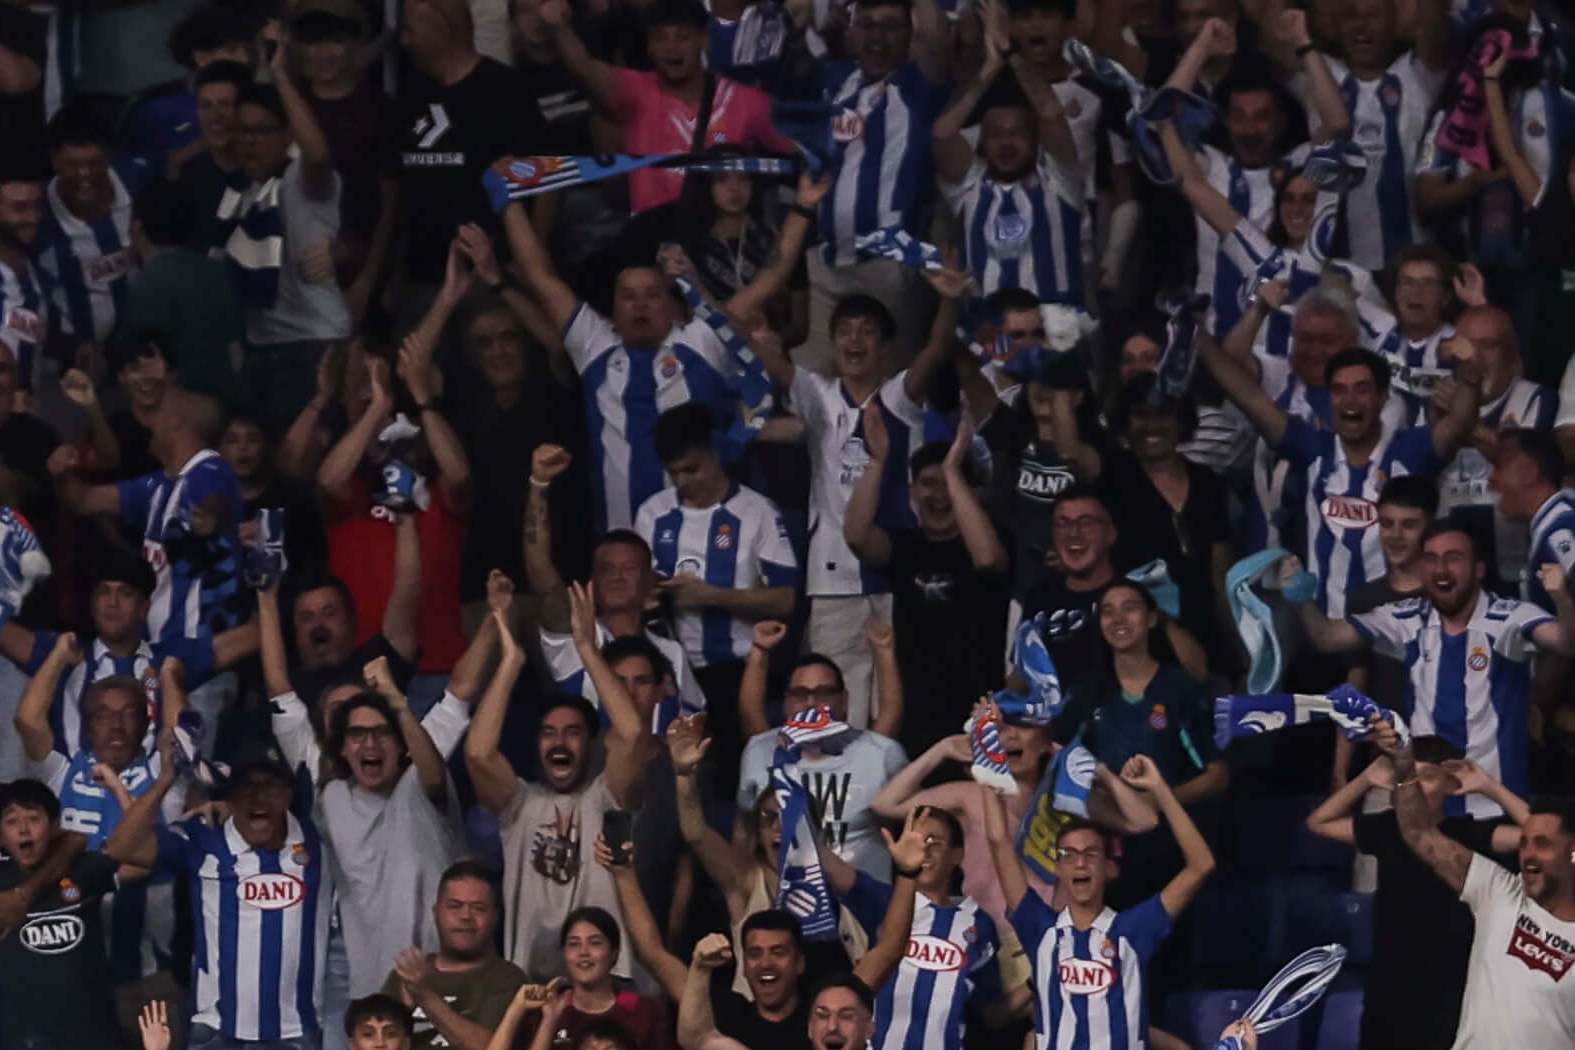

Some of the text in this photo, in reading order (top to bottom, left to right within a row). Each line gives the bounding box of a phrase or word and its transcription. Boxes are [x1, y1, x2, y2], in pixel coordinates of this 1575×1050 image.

[1328, 500, 1374, 521] DANI
[245, 882, 295, 901] DANI
[26, 921, 77, 945] DANI
[906, 940, 956, 966] DANI
[1059, 964, 1104, 986] DANI
